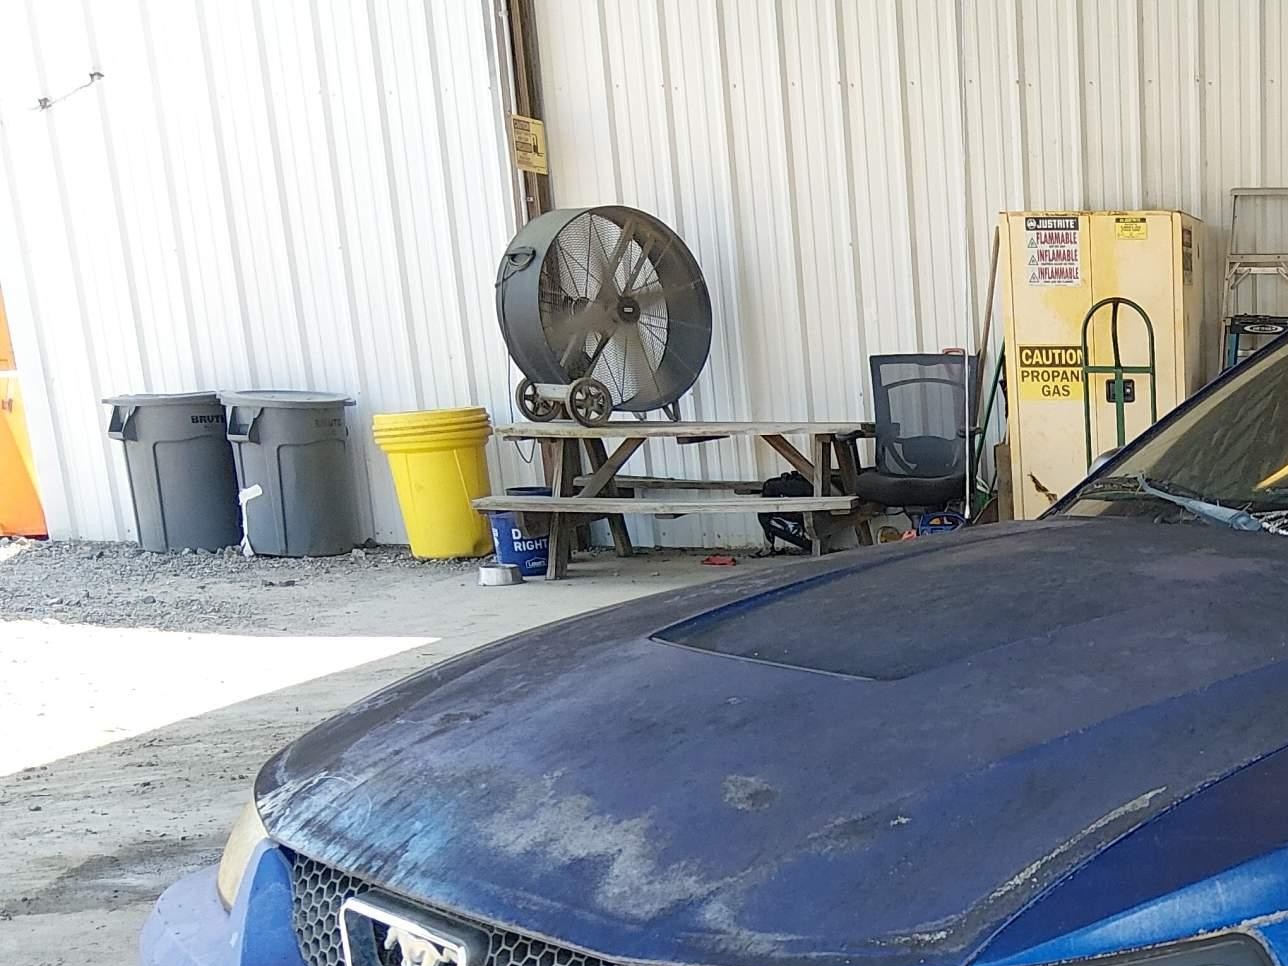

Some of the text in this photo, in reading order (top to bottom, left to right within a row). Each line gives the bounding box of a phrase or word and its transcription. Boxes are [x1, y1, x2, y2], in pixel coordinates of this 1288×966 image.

[1036, 218, 1076, 229] JUSTRITE
[1036, 231, 1078, 245] FLAMMABLE
[1037, 249, 1079, 262] INFLAMABLE
[1038, 266, 1080, 280] INFLAMMABLE
[1021, 349, 1083, 365] CAUTION
[1041, 384, 1071, 397] GAS
[513, 538, 548, 552] RIGHT
